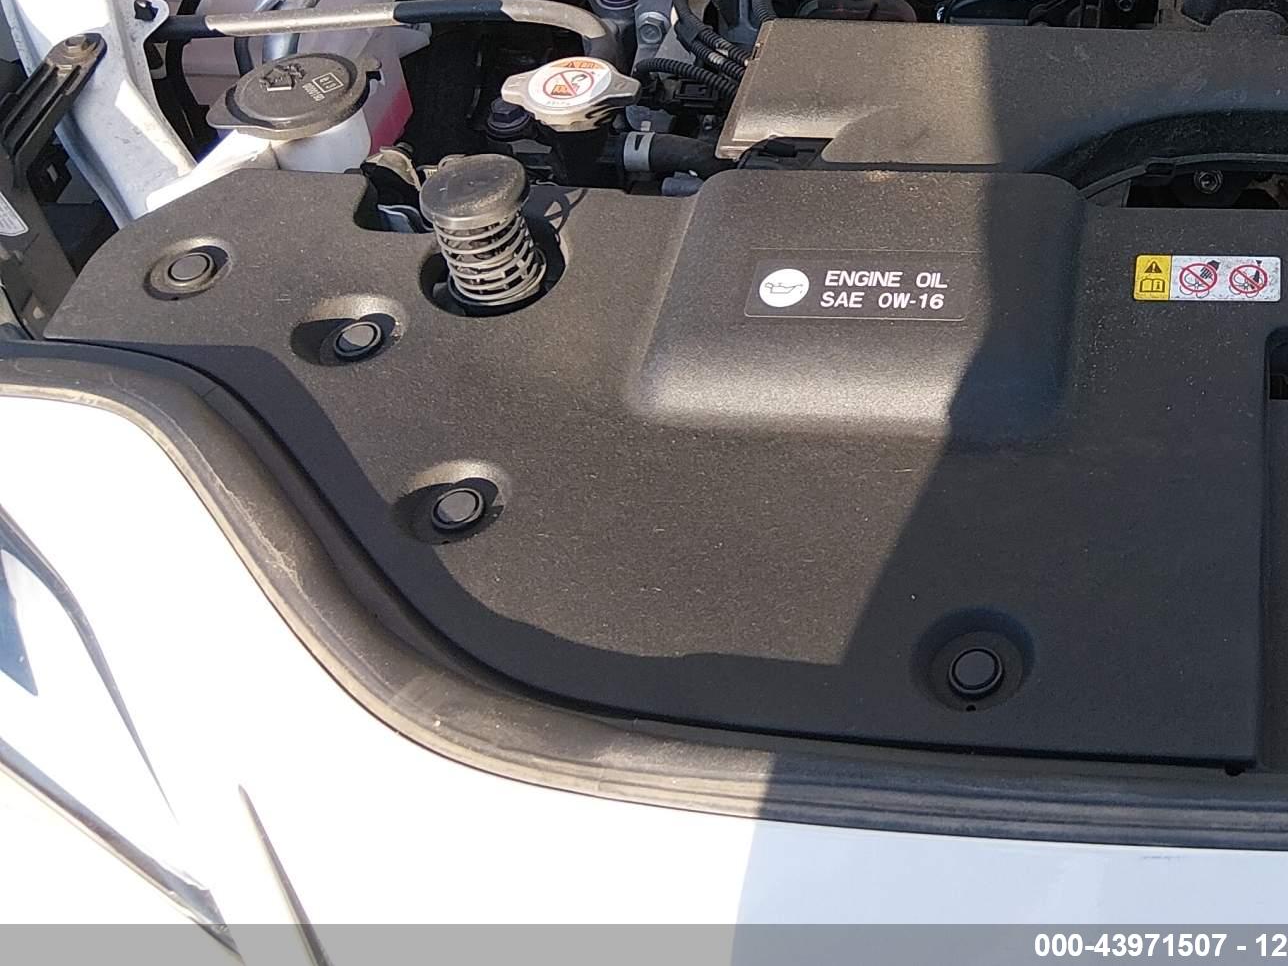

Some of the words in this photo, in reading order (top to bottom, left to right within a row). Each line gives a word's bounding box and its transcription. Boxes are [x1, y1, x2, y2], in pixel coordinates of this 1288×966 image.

[824, 270, 903, 288] ENGINE
[915, 271, 949, 289] OIL
[820, 291, 865, 308] SAE
[877, 292, 945, 310] 0W-16
